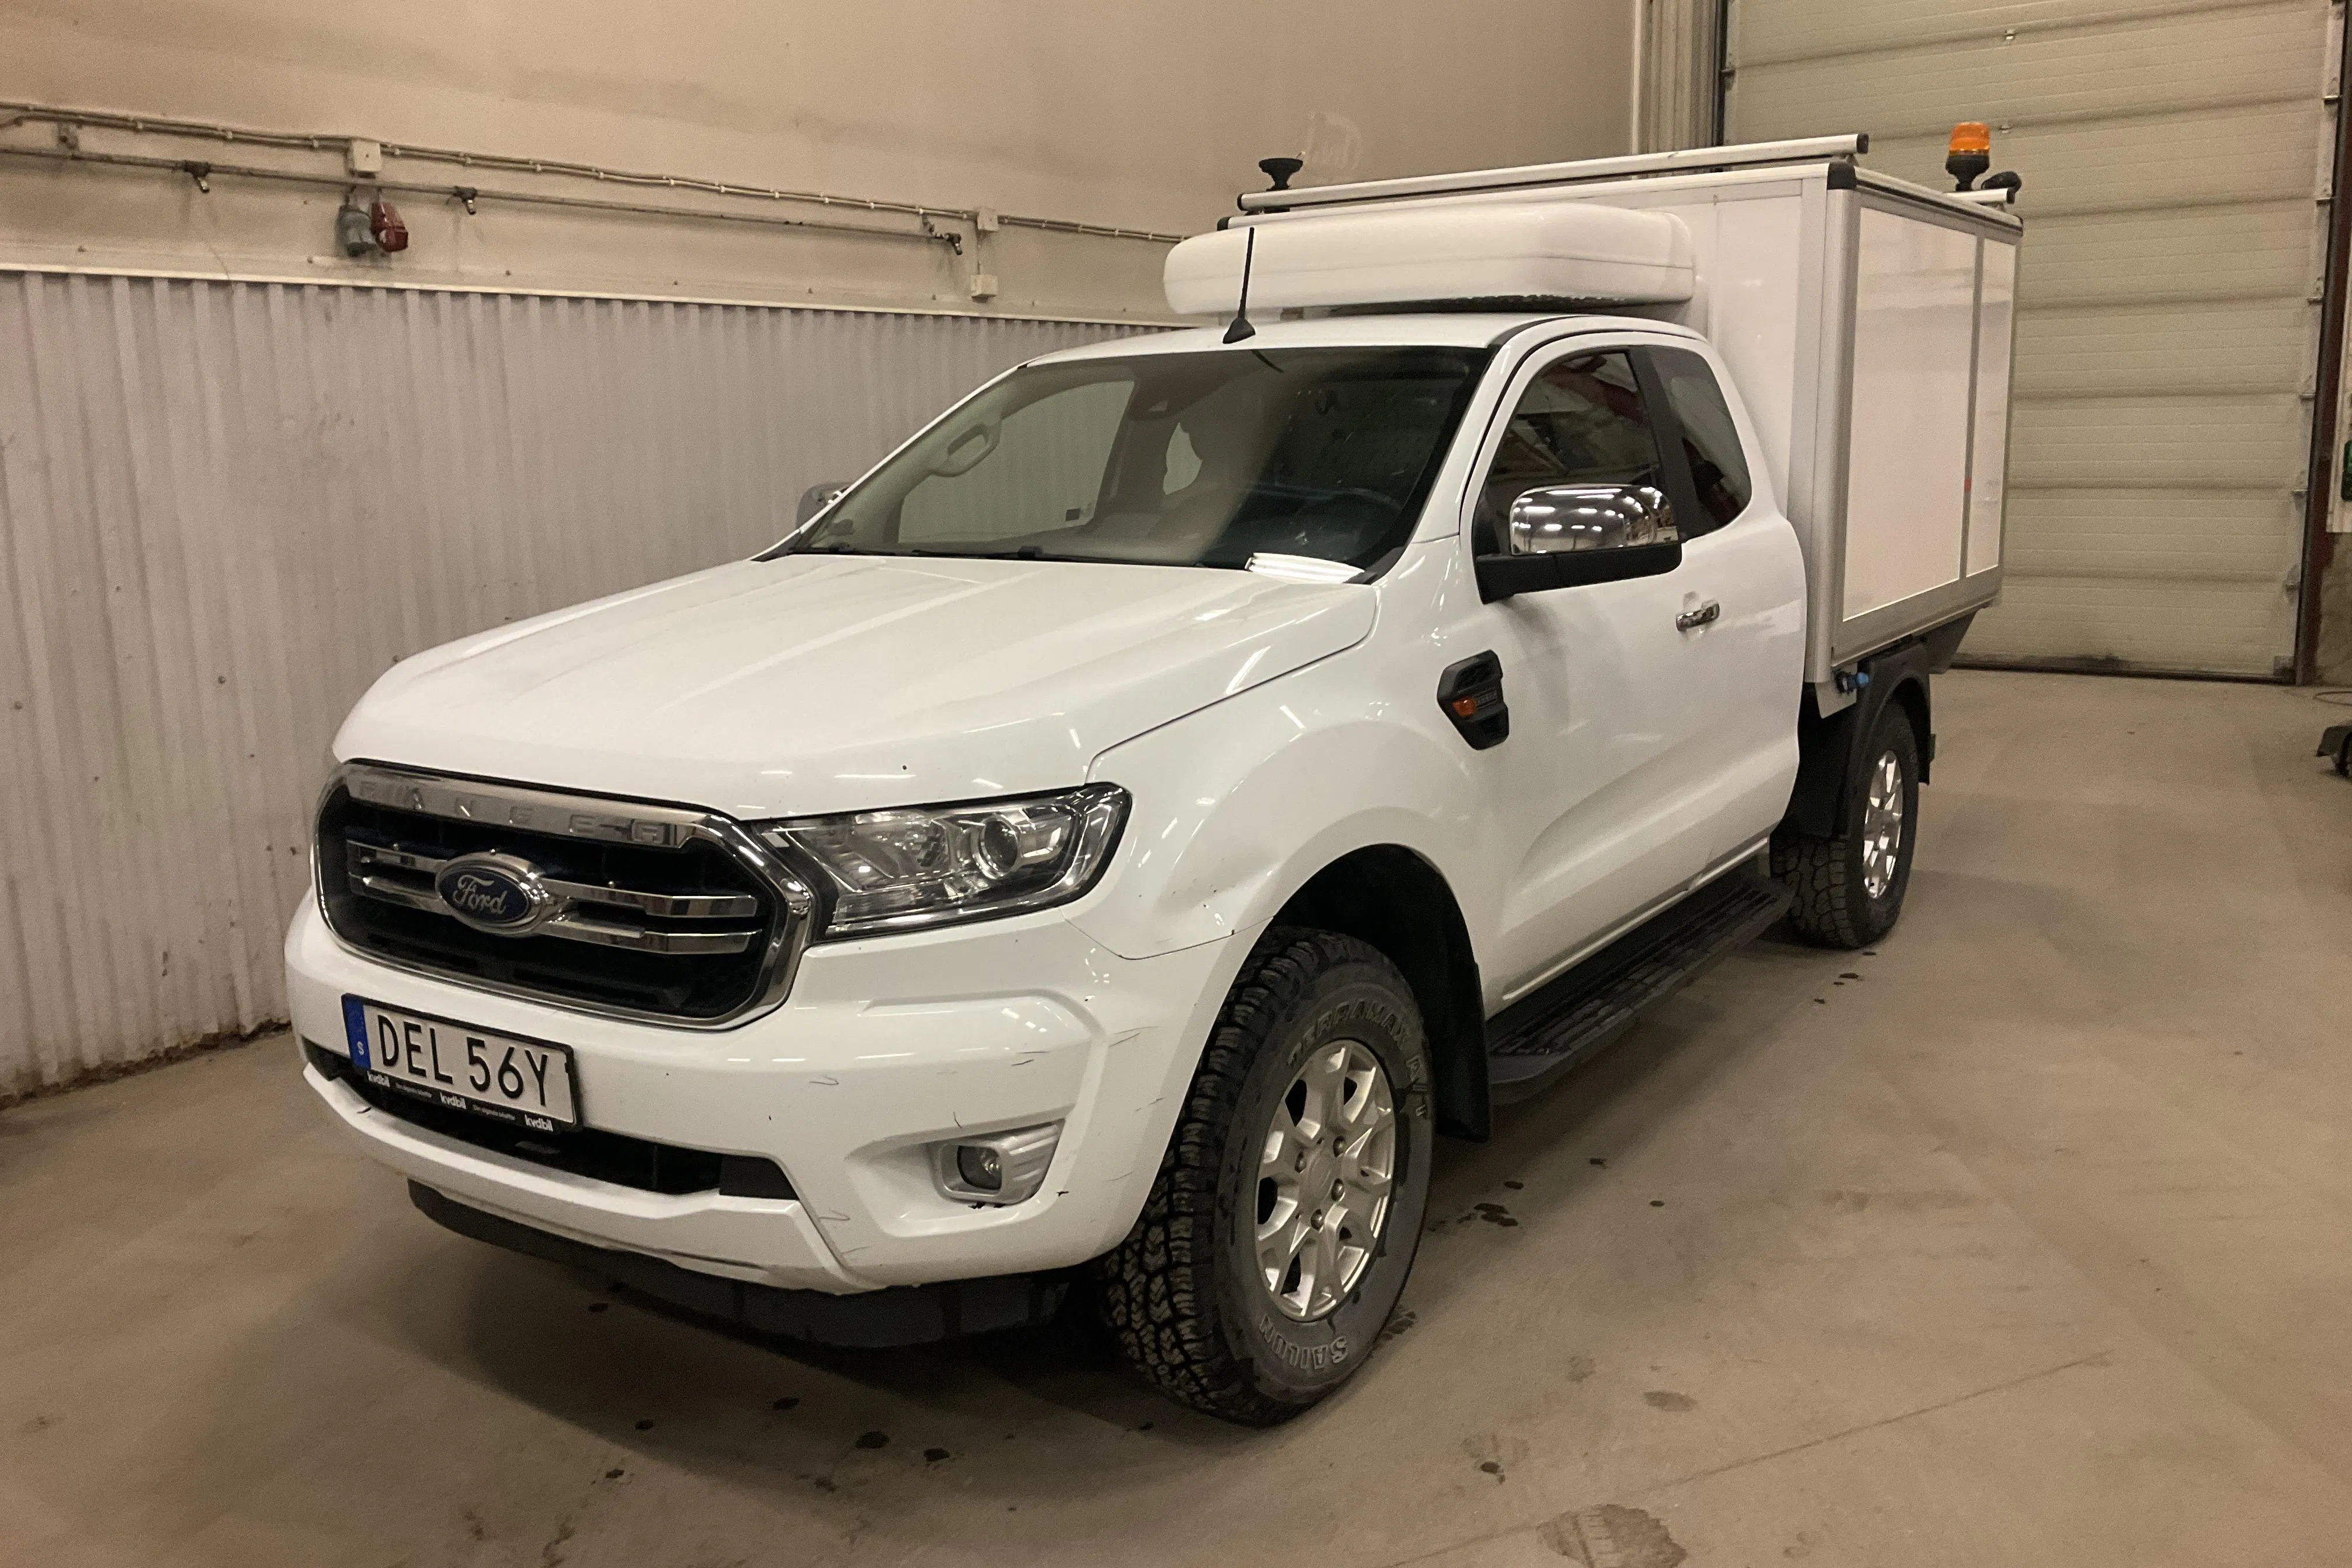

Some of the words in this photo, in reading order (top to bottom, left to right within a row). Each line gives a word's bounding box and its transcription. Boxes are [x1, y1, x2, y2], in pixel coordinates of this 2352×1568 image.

[452, 874, 509, 915] Ford
[356, 1041, 365, 1056] S
[377, 1014, 453, 1084] DEL
[466, 1037, 548, 1107] 56Y
[367, 1070, 390, 1087] kvdbil
[440, 1092, 467, 1109] kvdbil
[524, 1115, 554, 1132] kvdbil
[1259, 1315, 1349, 1370] SAILUN
